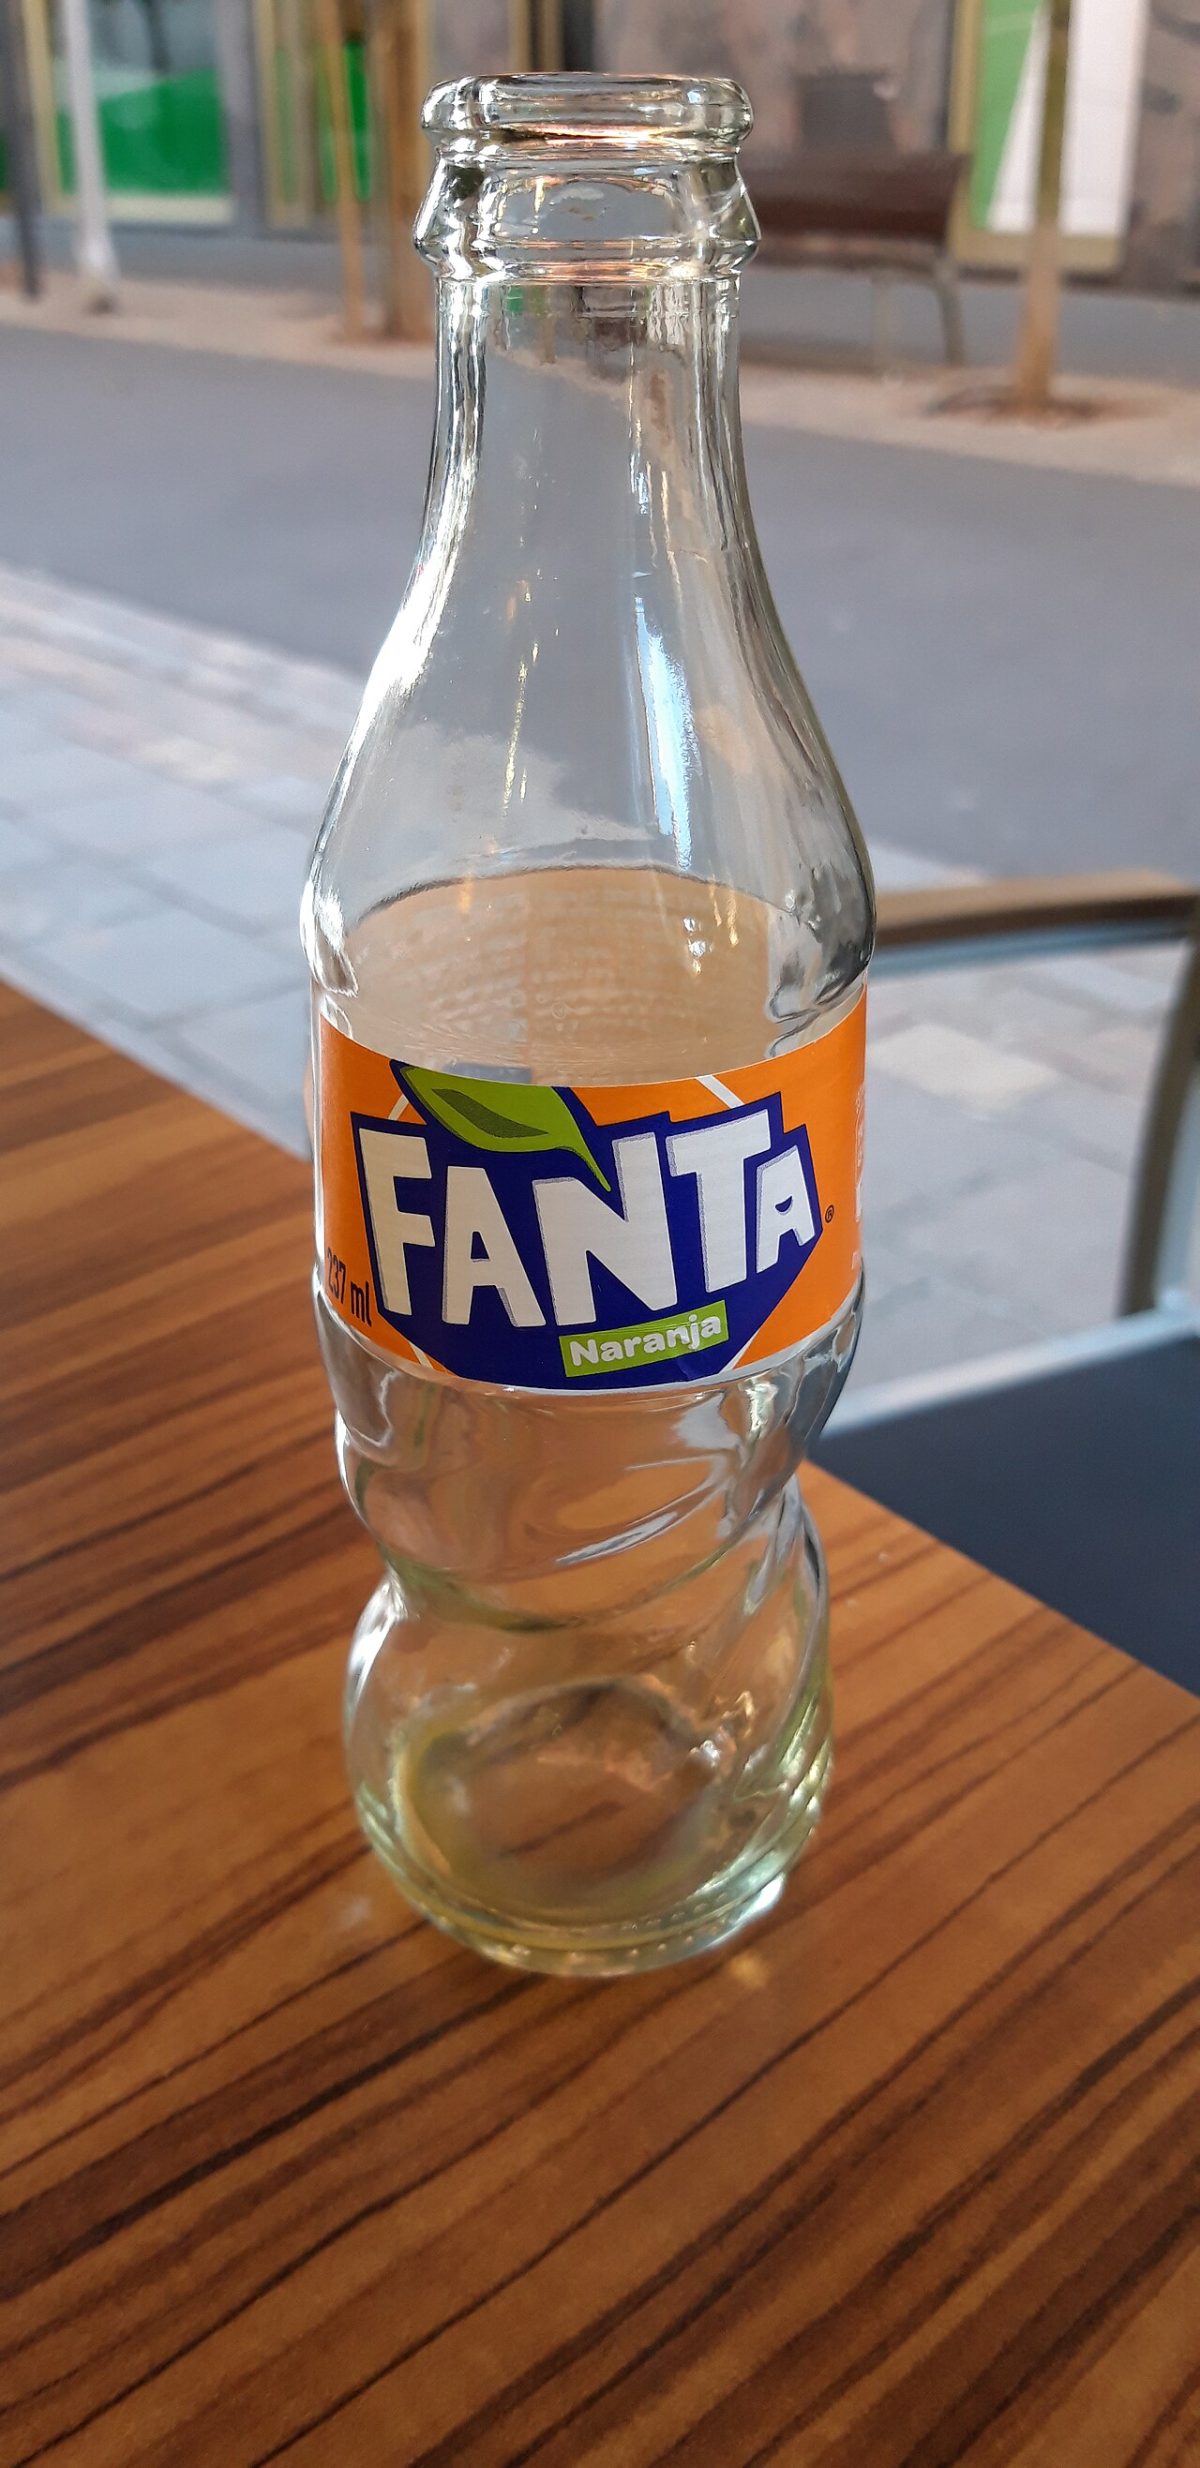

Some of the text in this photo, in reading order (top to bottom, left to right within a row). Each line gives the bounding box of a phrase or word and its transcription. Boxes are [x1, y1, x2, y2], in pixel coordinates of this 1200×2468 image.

[358, 1108, 816, 1328] FANTA
[327, 1247, 371, 1327] 237 ml
[570, 1314, 721, 1366] Naranja
